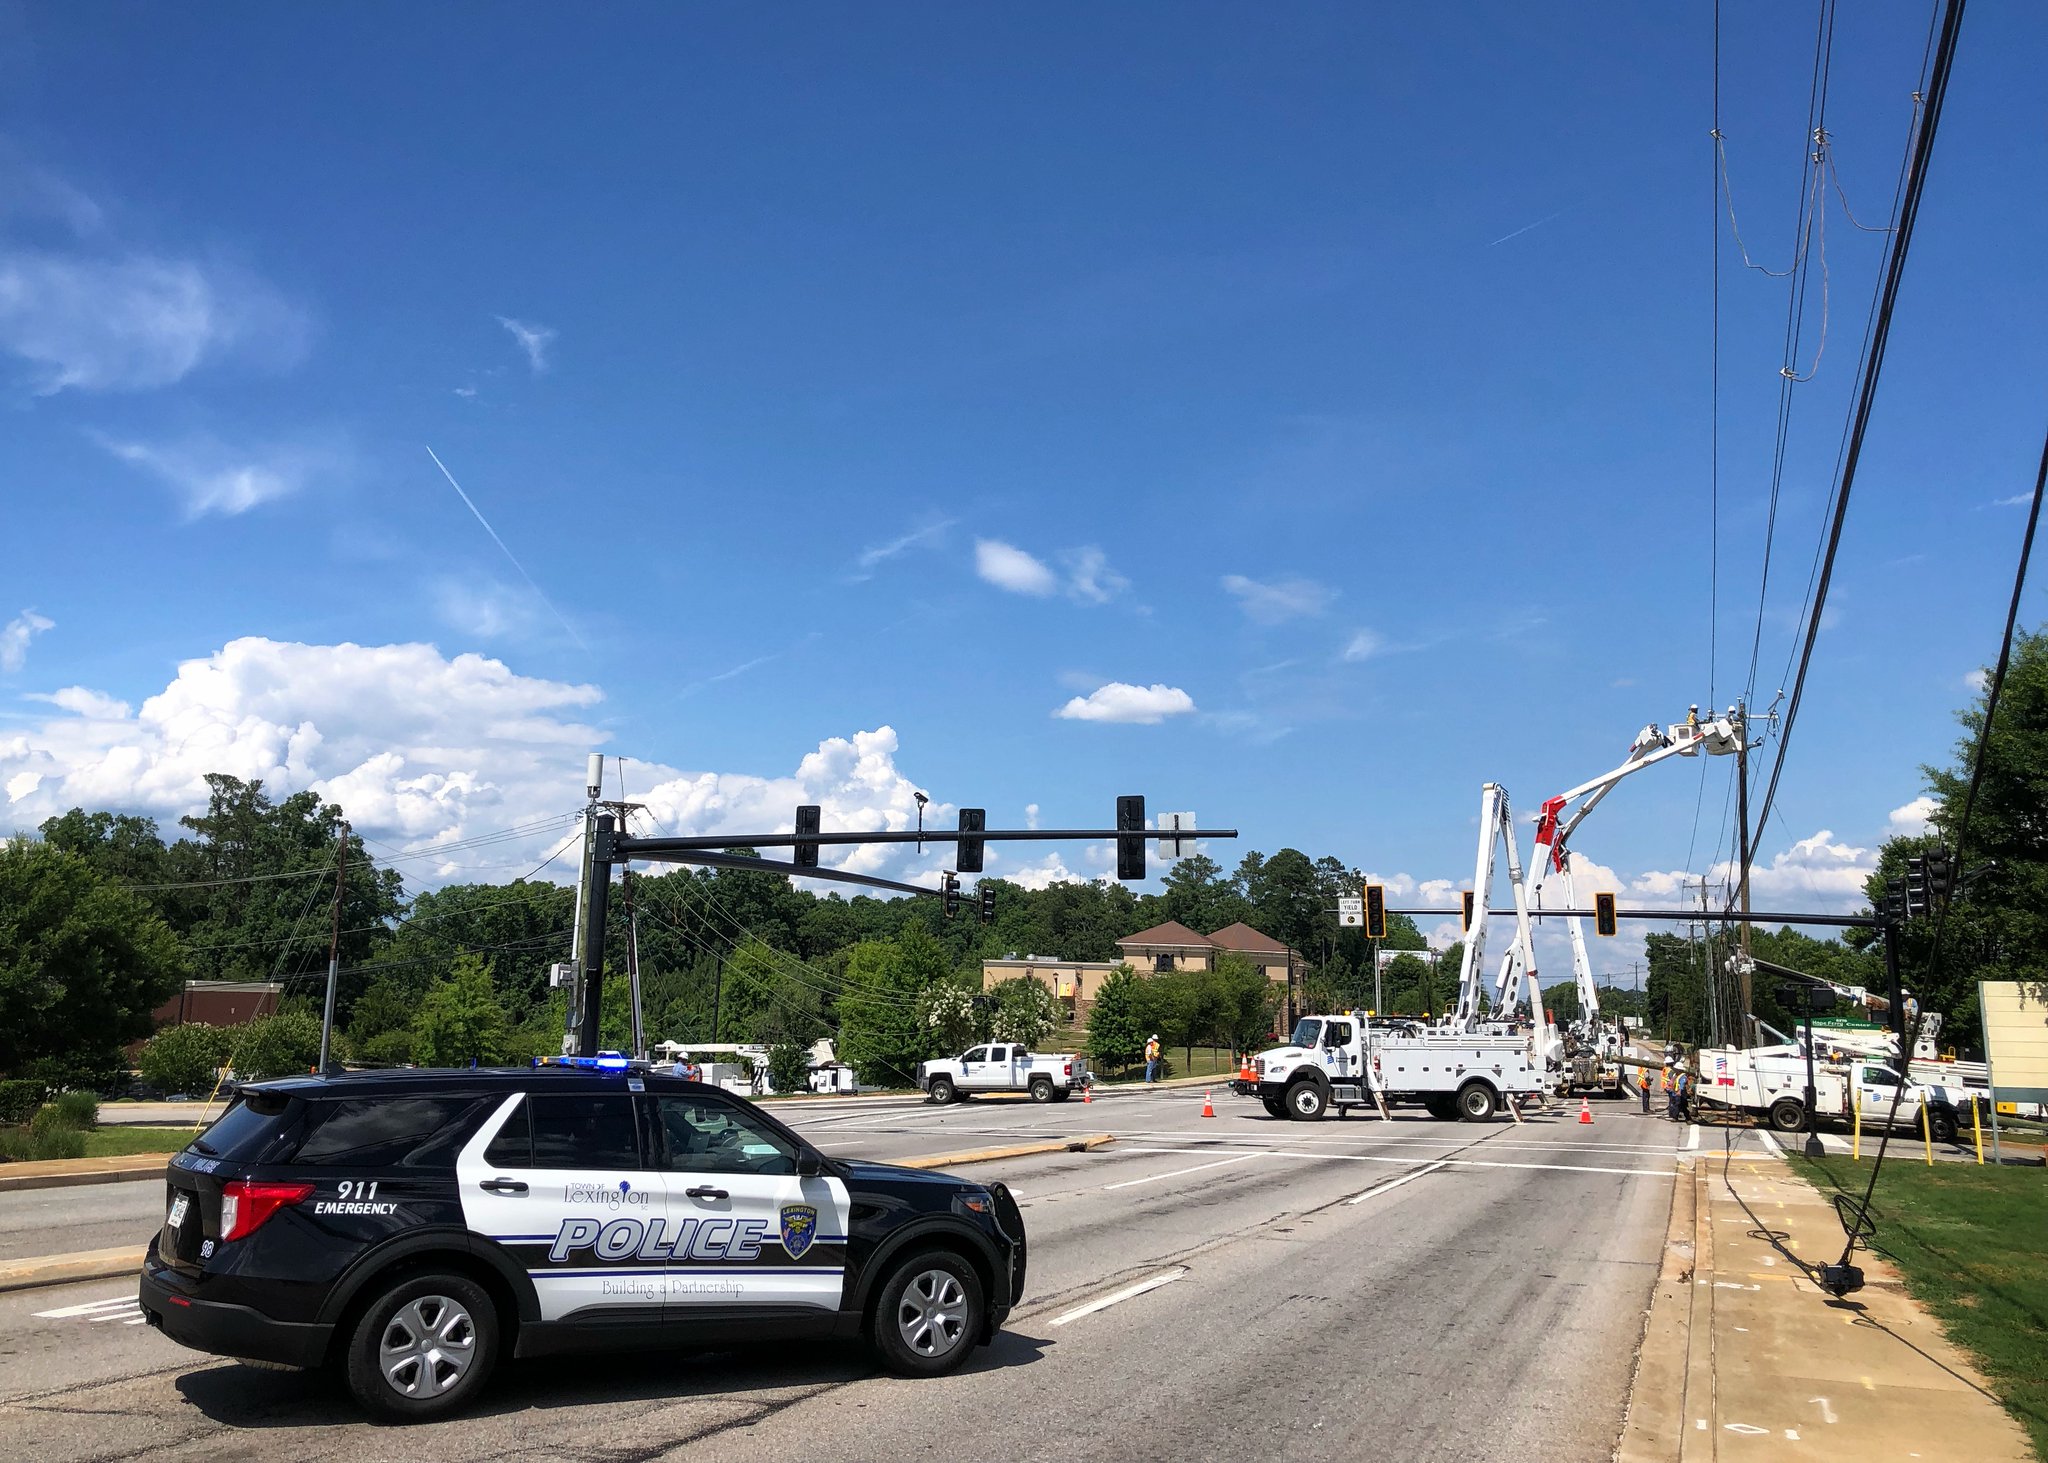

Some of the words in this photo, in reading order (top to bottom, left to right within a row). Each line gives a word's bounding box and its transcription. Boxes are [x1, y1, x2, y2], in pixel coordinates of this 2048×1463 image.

[337, 1180, 379, 1200] 911
[570, 1182, 595, 1190] TOWN
[564, 1181, 649, 1211] Lexington
[314, 1202, 398, 1215] EMERGENCY
[783, 1206, 816, 1215] LEXINGTON
[200, 1239, 215, 1258] 98
[549, 1218, 769, 1261] POLICE
[602, 1279, 655, 1299] Building
[659, 1285, 666, 1294] a
[672, 1279, 745, 1298] Partnership
